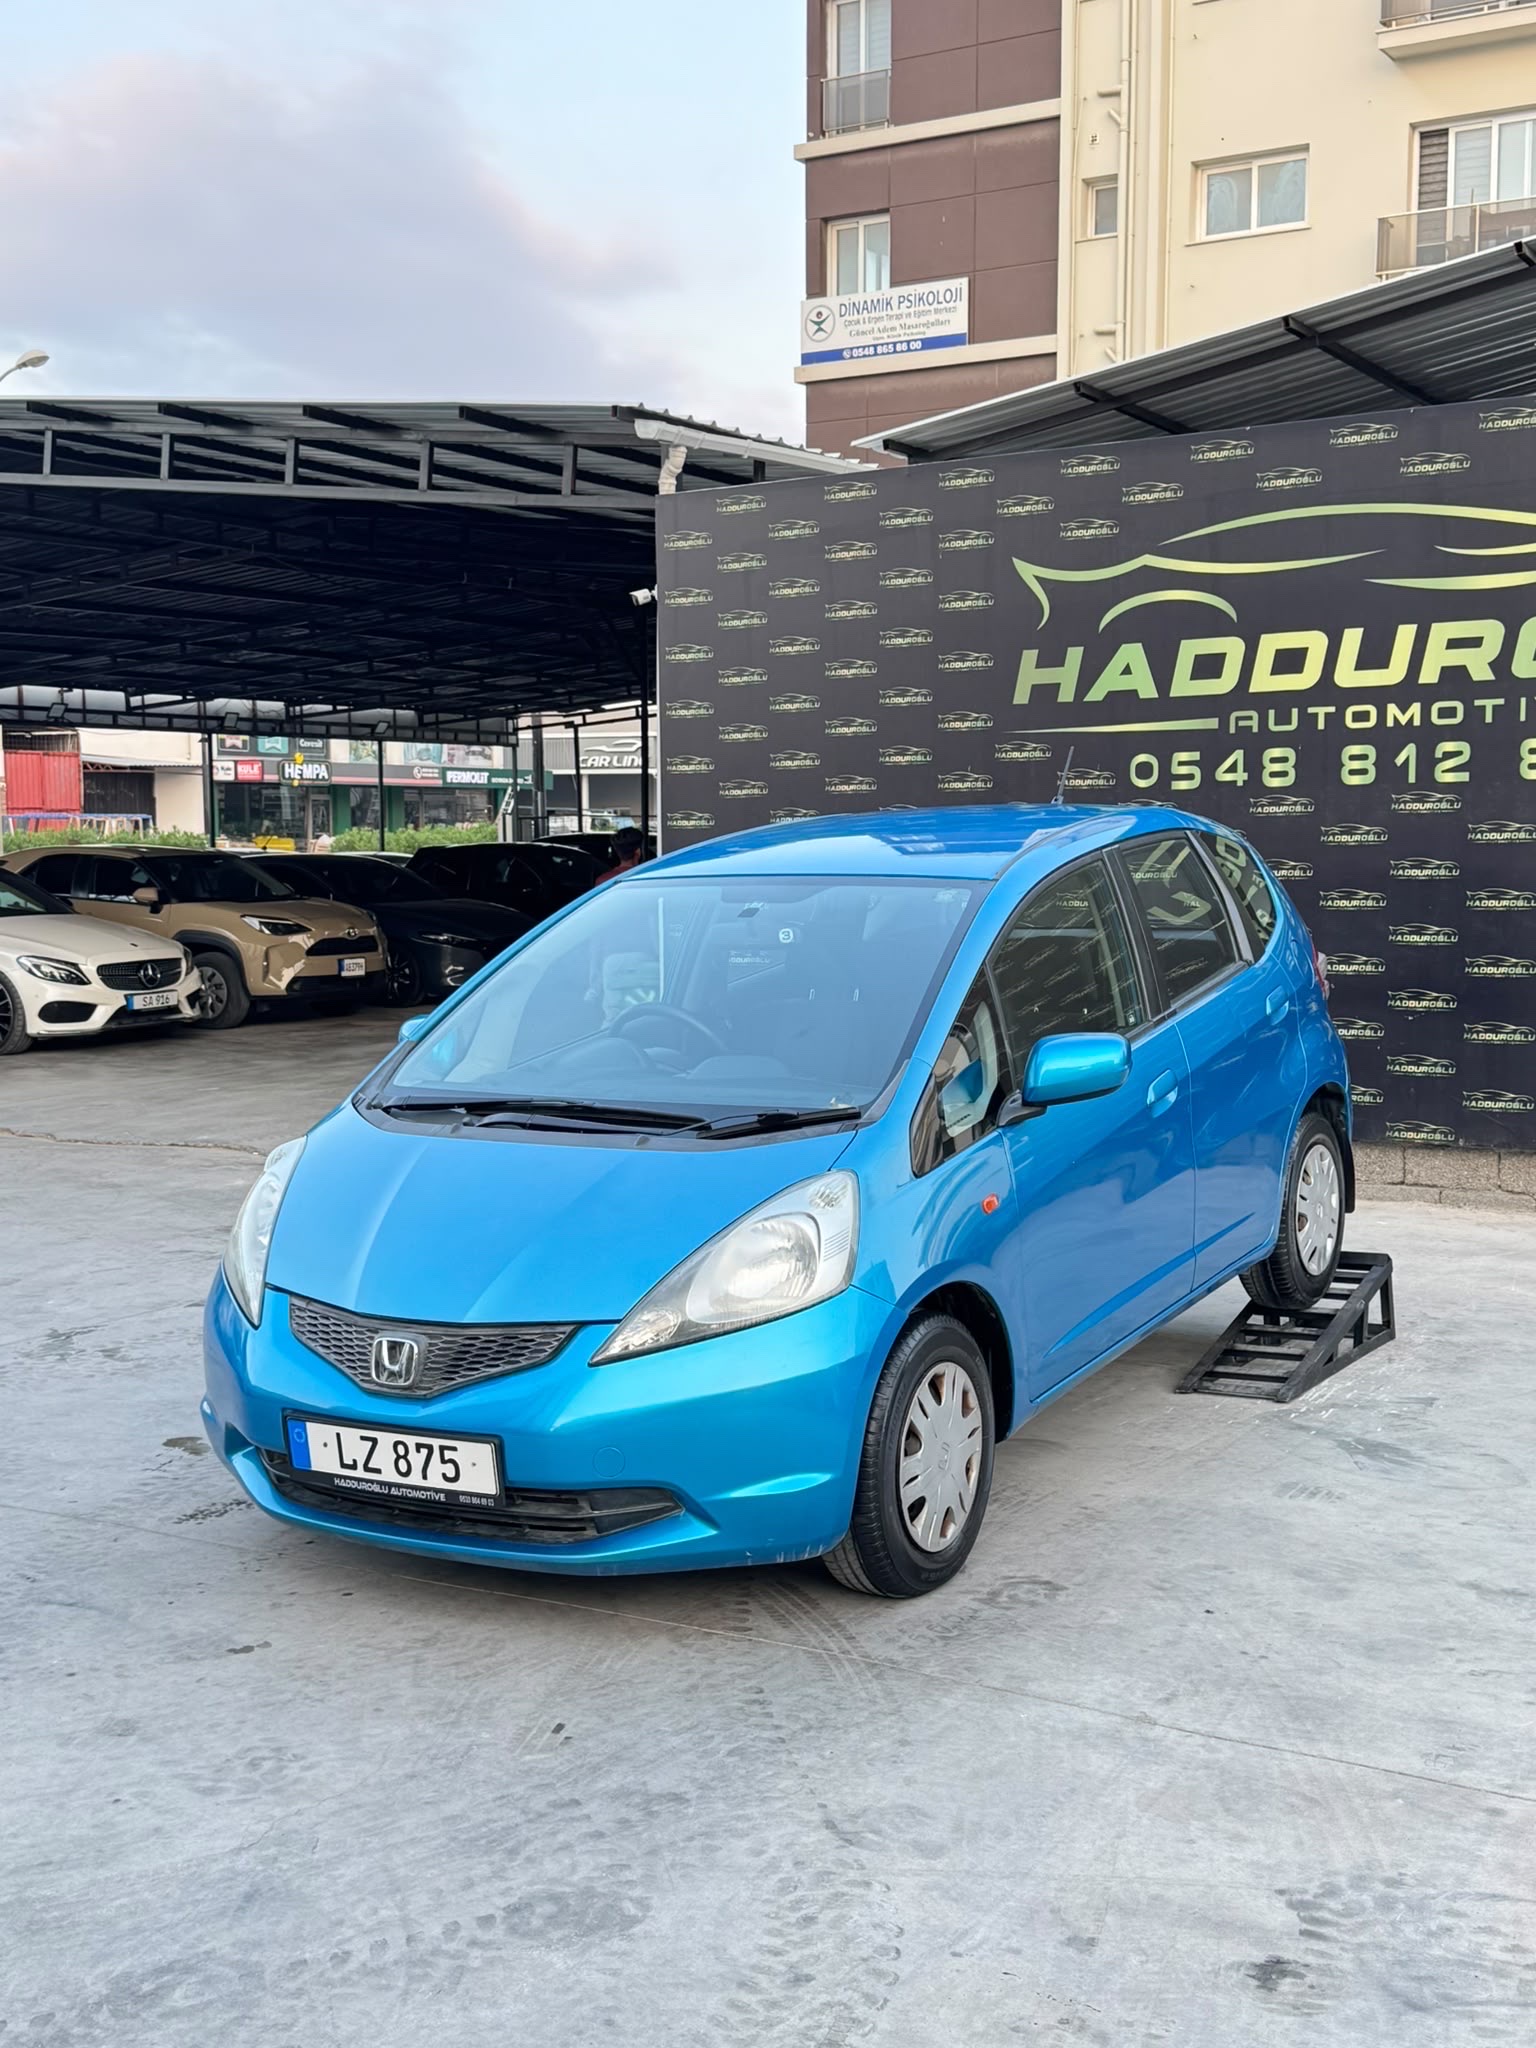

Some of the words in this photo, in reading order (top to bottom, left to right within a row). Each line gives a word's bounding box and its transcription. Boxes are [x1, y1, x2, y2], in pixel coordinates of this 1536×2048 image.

[840, 292, 893, 318] DİNAMİK
[898, 283, 962, 310] PSİKOLOJİ
[852, 345, 874, 358] 0548
[909, 340, 922, 350] 00
[1229, 697, 1536, 734] AUTOMOTI
[284, 763, 328, 779] HEMPA
[580, 755, 611, 767] CAR
[613, 755, 642, 767] LIN
[1130, 747, 1297, 791] 0548
[1340, 741, 1471, 786] 812
[142, 996, 153, 1007] SA
[155, 994, 170, 1005] 916
[336, 1432, 382, 1475] LZ
[392, 1440, 461, 1483] 875
